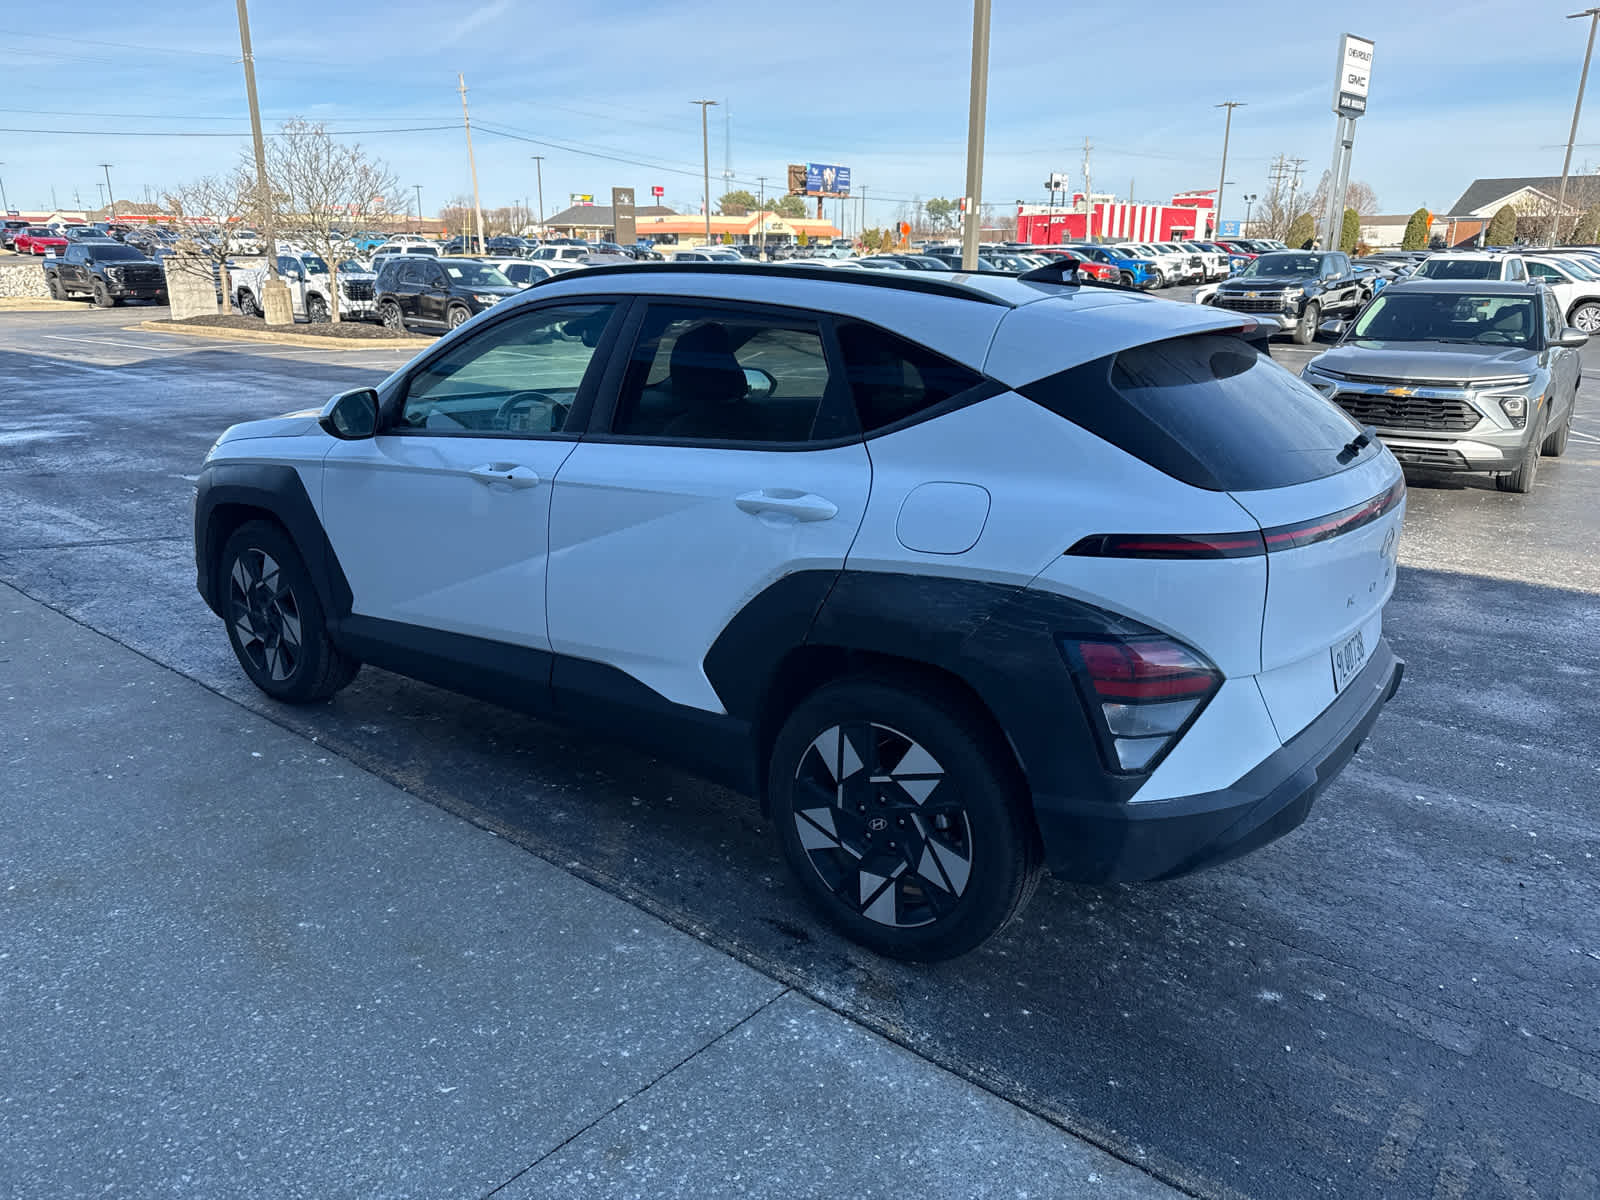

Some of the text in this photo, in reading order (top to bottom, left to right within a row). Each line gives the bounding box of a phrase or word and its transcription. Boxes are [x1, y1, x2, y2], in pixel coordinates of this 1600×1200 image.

[1348, 48, 1371, 62] CHEVROLET
[1348, 74, 1366, 87] GMC
[1051, 216, 1066, 224] KFC
